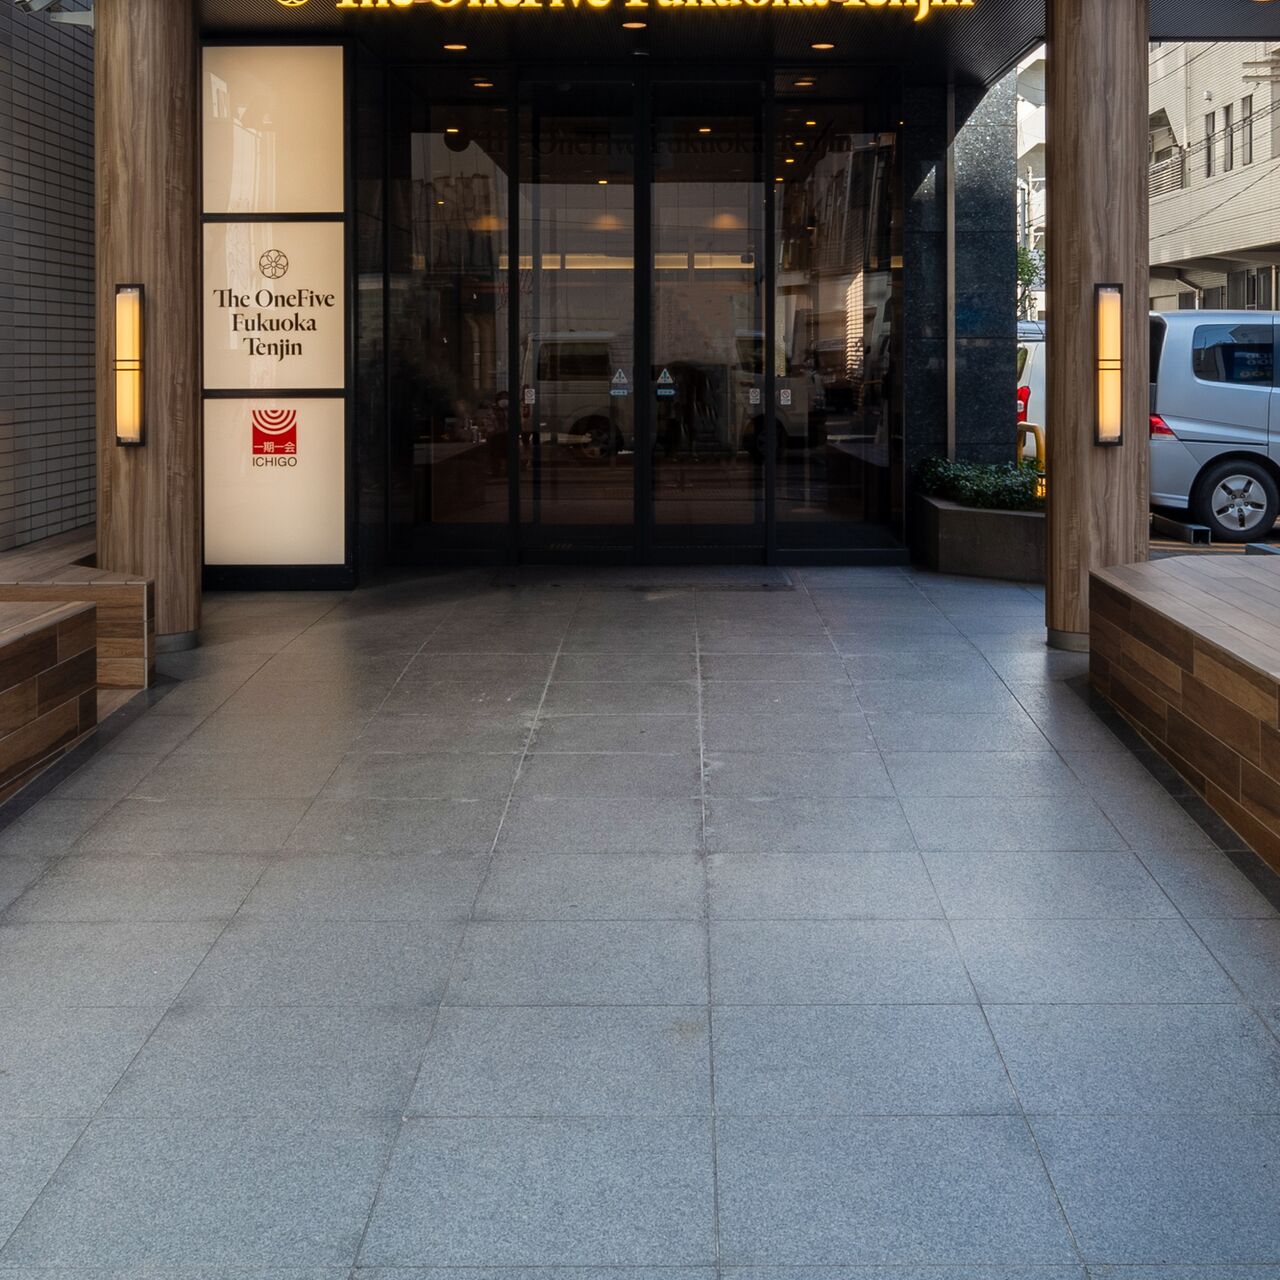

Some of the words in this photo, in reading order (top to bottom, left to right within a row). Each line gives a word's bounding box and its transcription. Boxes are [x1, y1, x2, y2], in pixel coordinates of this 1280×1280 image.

[213, 289, 250, 308] The
[255, 289, 335, 308] OneFive
[232, 312, 317, 332] Fukuoka
[243, 338, 303, 362] Tenjin
[254, 442, 295, 452] 一期一会
[252, 456, 298, 467] ICHIGO
